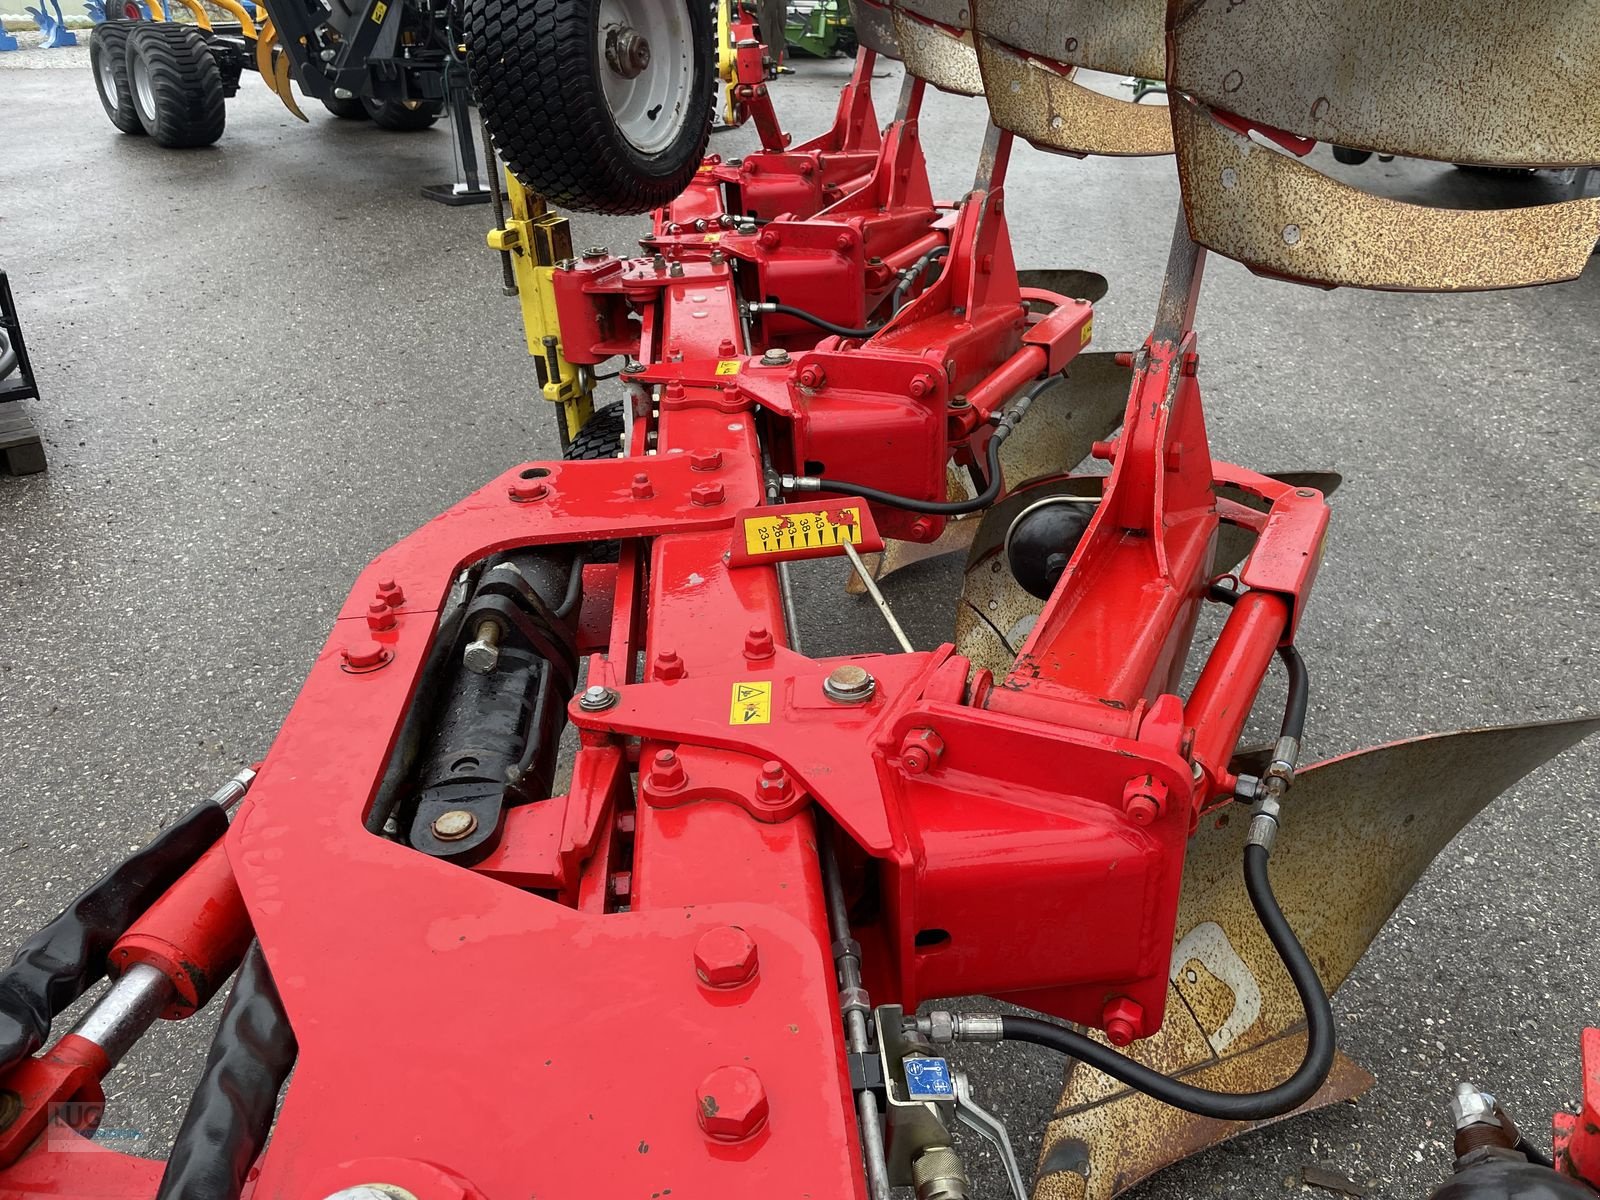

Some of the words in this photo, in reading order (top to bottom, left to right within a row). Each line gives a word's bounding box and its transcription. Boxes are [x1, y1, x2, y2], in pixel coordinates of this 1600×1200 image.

[772, 524, 783, 538] 28
[800, 518, 811, 532] 38
[758, 526, 769, 540] 23
